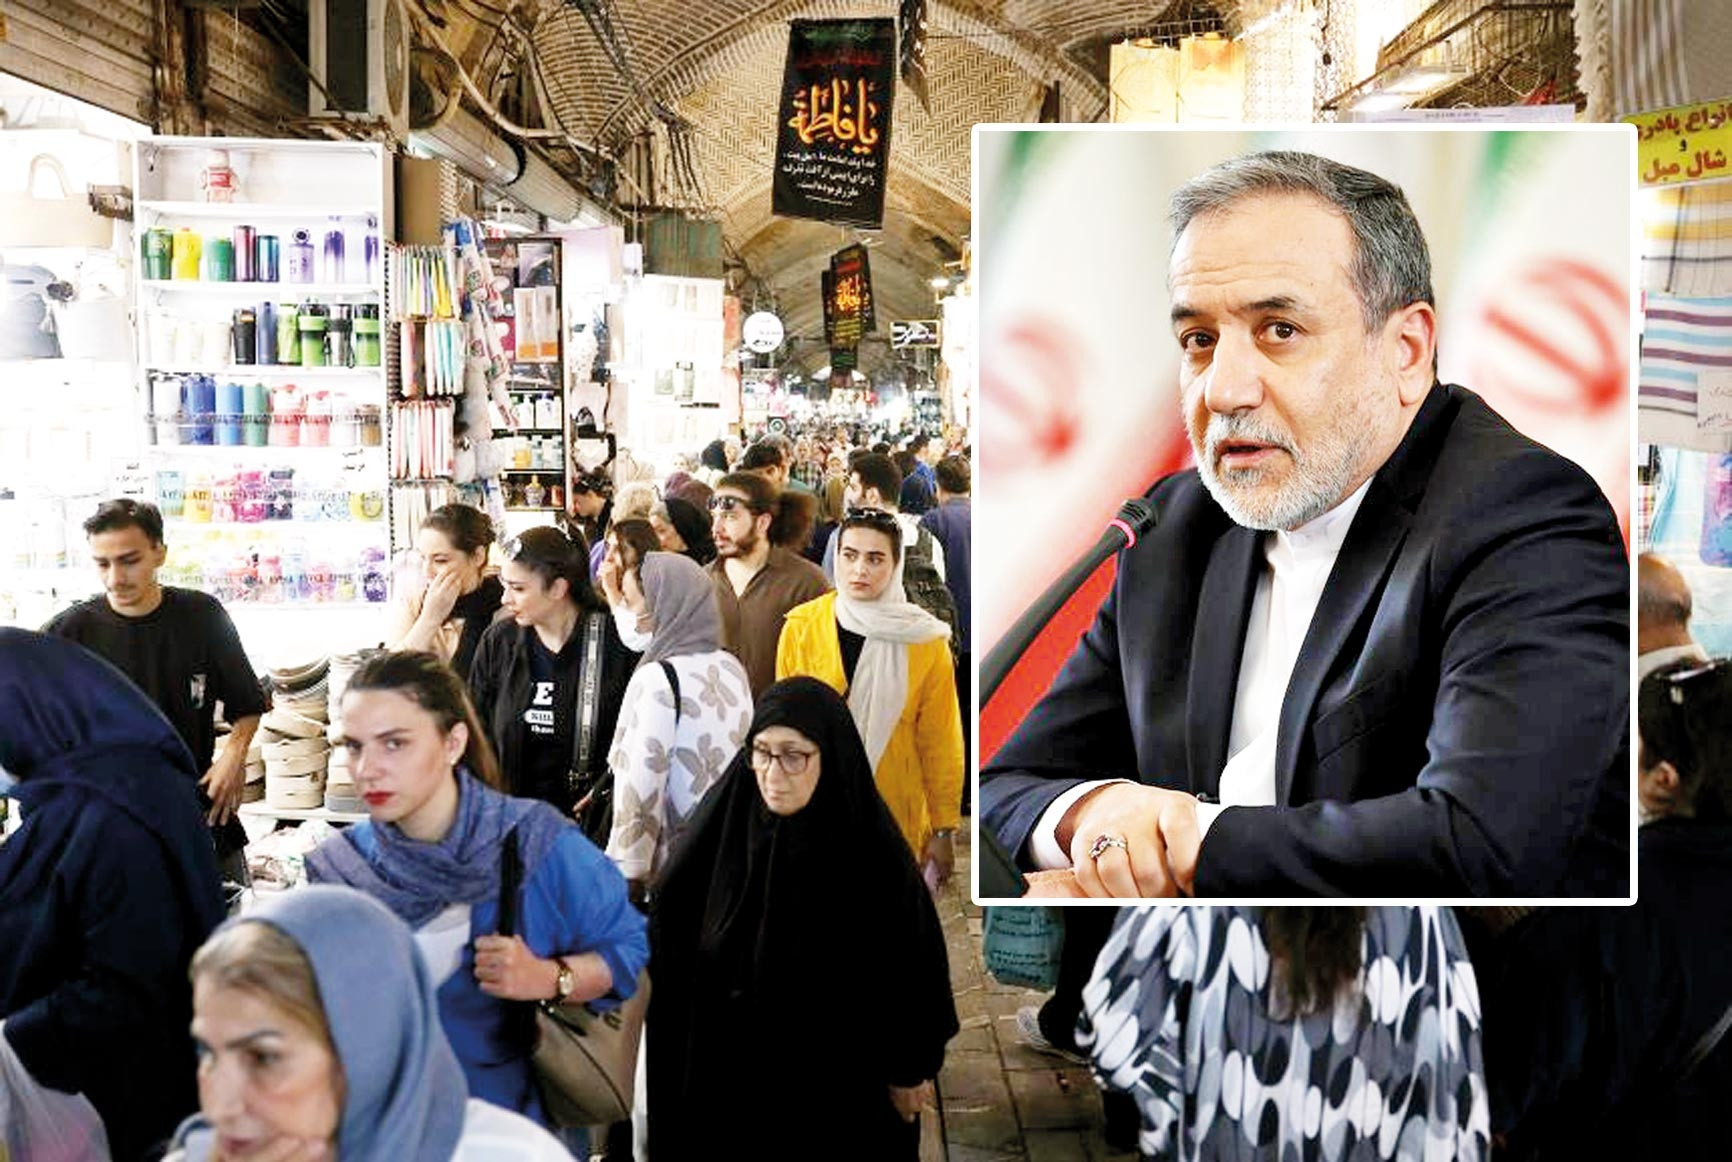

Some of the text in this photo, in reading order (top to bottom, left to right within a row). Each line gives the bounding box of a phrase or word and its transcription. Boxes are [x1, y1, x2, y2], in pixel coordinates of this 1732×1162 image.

[1679, 139, 1687, 152] و
[1643, 148, 1726, 183] شال مبل
